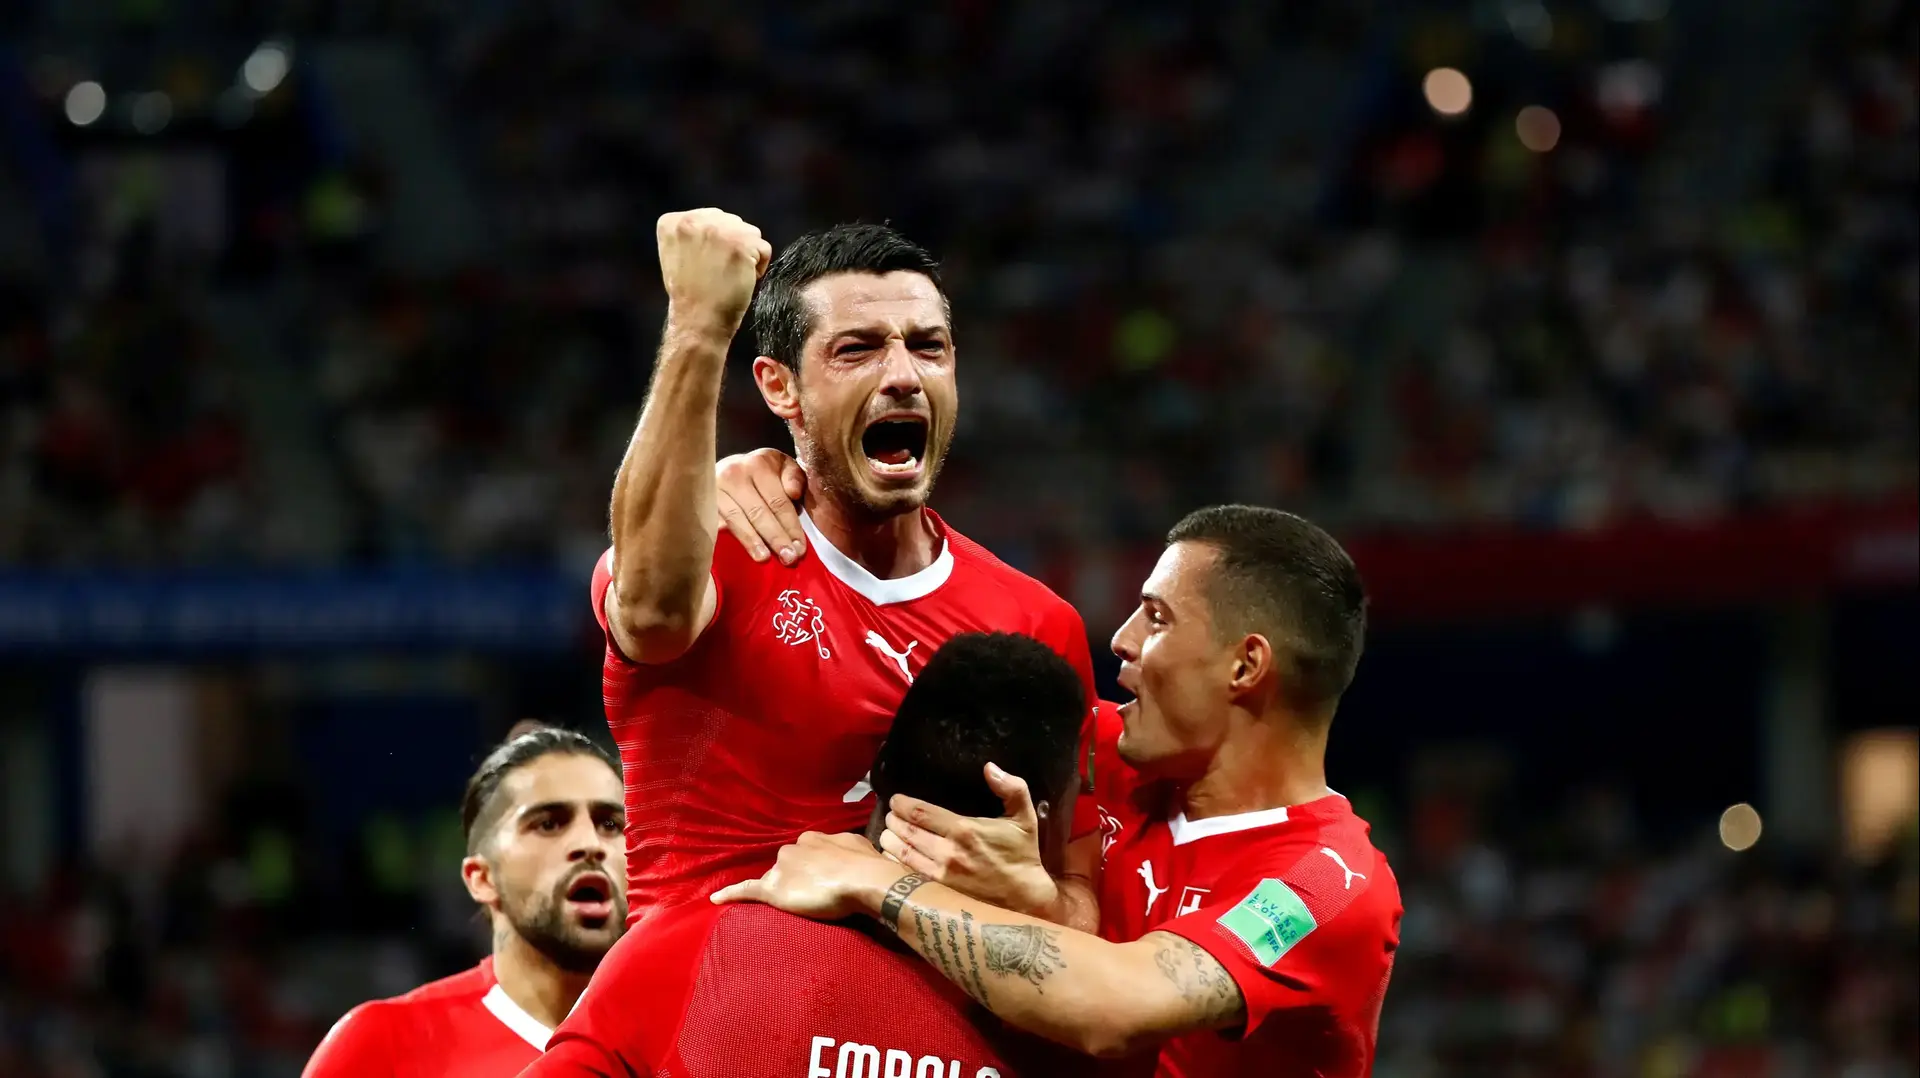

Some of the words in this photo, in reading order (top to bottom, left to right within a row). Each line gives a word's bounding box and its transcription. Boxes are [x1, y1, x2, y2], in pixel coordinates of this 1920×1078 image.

[1248, 899, 1291, 943] FOOTBALL
[1253, 893, 1298, 939] LIVING
[1265, 930, 1280, 953] FIFA
